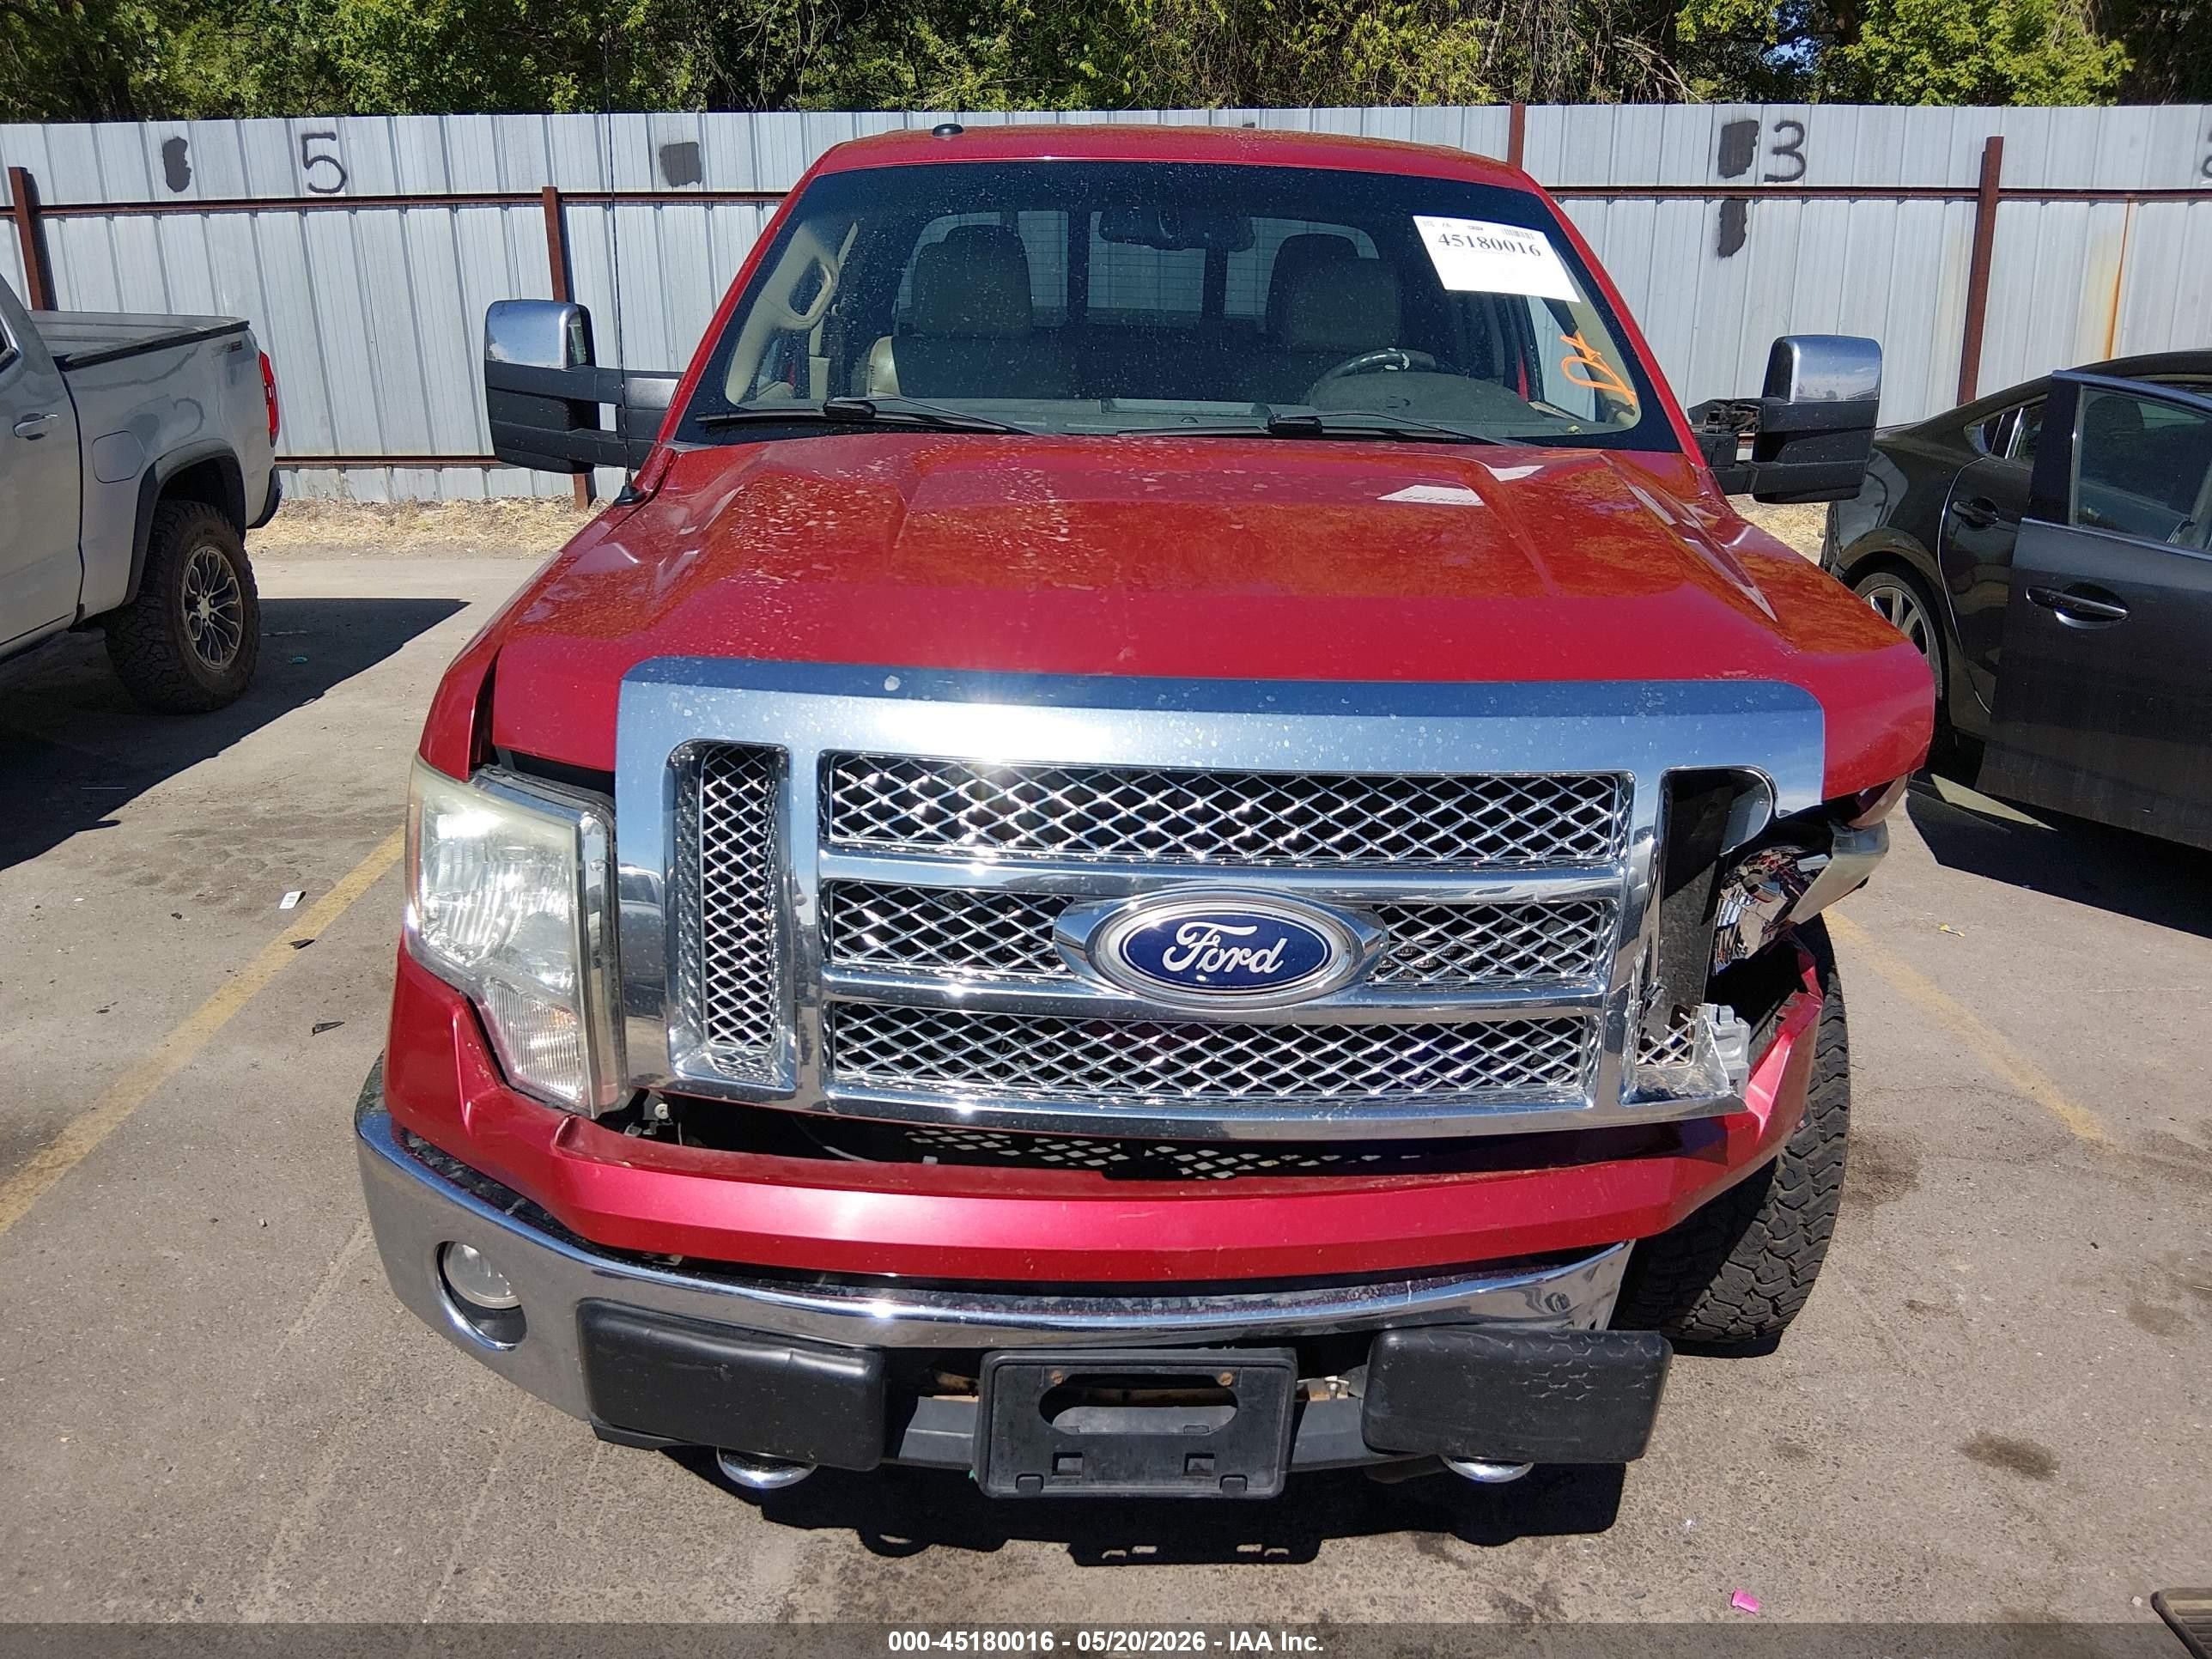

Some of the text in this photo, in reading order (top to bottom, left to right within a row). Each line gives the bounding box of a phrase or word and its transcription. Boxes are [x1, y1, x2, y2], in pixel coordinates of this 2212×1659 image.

[301, 131, 347, 194] 5
[1764, 120, 1806, 182] 3
[1437, 233, 1541, 257] 45180016
[1162, 921, 1288, 974] Ford
